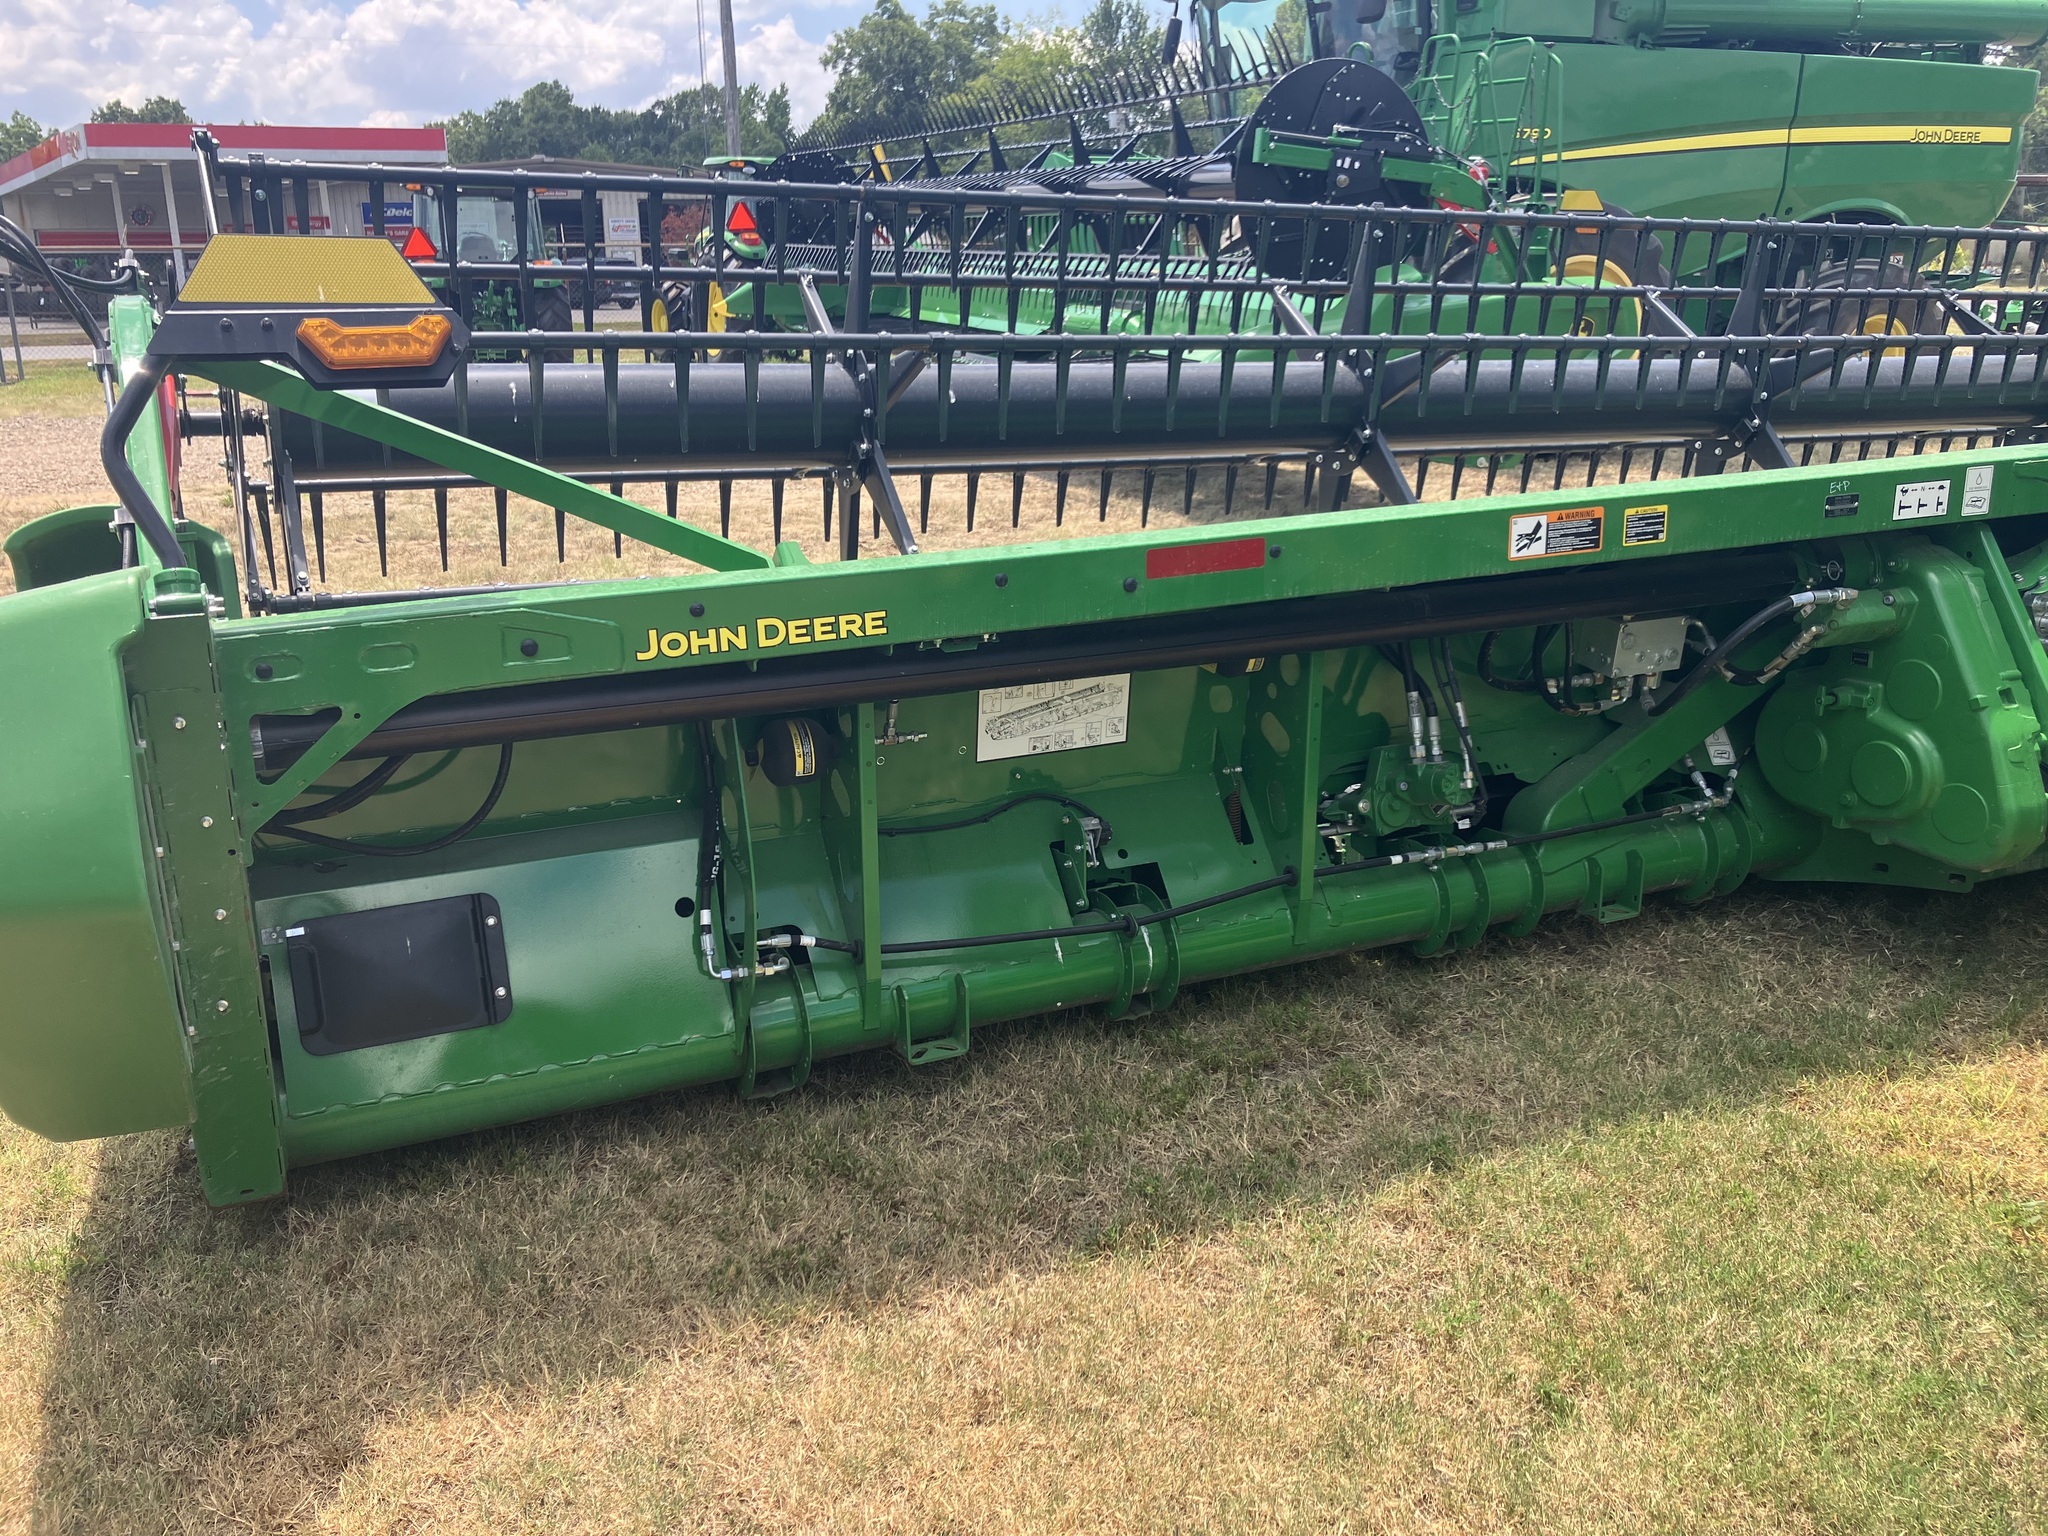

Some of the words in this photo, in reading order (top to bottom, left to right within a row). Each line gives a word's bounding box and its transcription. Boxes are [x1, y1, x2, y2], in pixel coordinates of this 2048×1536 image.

[1910, 128, 1942, 142] JOHN
[1944, 129, 1982, 143] DEERE
[1564, 509, 1596, 520] WARNING
[635, 624, 748, 662] JOHN
[755, 609, 888, 648] DEERE
[792, 732, 802, 754] CAUTION
